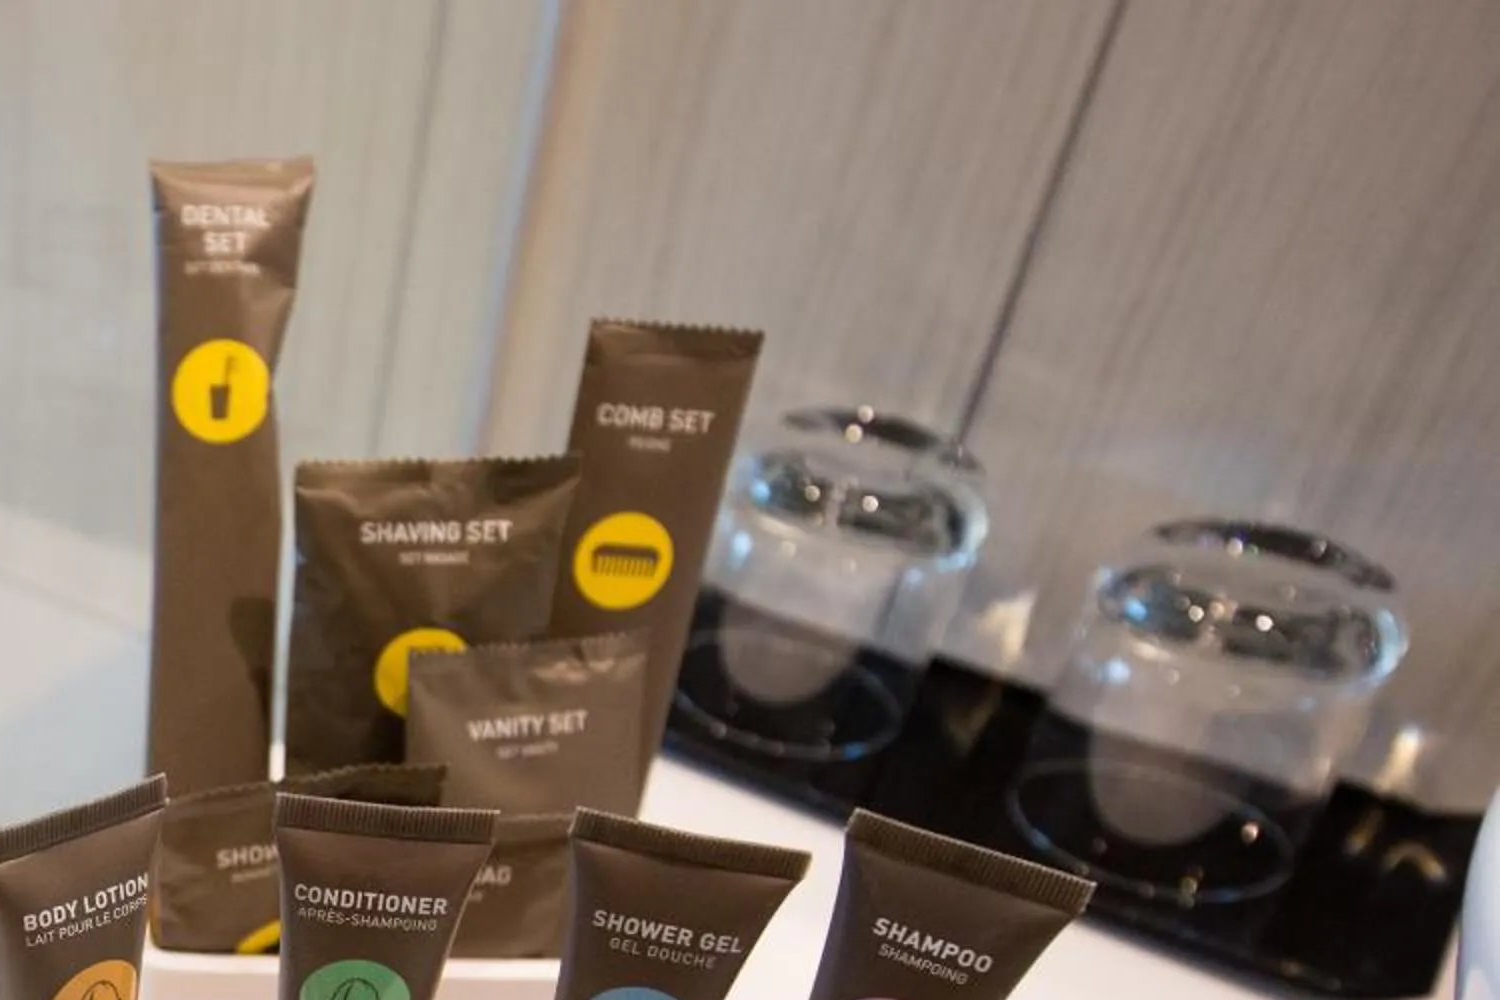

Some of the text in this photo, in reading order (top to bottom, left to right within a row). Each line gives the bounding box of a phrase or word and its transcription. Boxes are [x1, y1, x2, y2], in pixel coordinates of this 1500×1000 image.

[180, 204, 272, 229] DENTAL
[203, 231, 247, 256] SET
[596, 402, 716, 434] COMB SET
[360, 519, 513, 544] SHAVING SET
[466, 708, 589, 741] VANITY SET
[474, 865, 513, 887] AG
[23, 872, 149, 932] BODY LOTION
[294, 883, 448, 916] CONDITIONER
[26, 930, 55, 947] LAIT
[59, 917, 94, 940] POUR
[95, 911, 111, 927] LE
[298, 907, 438, 932] APRÈS-SHAMPOING
[592, 909, 745, 954] SHOWER GEL
[609, 937, 717, 969] GEL DOUCHE
[871, 917, 994, 973] SHAMPOO
[878, 942, 969, 985] SHAMPOING
